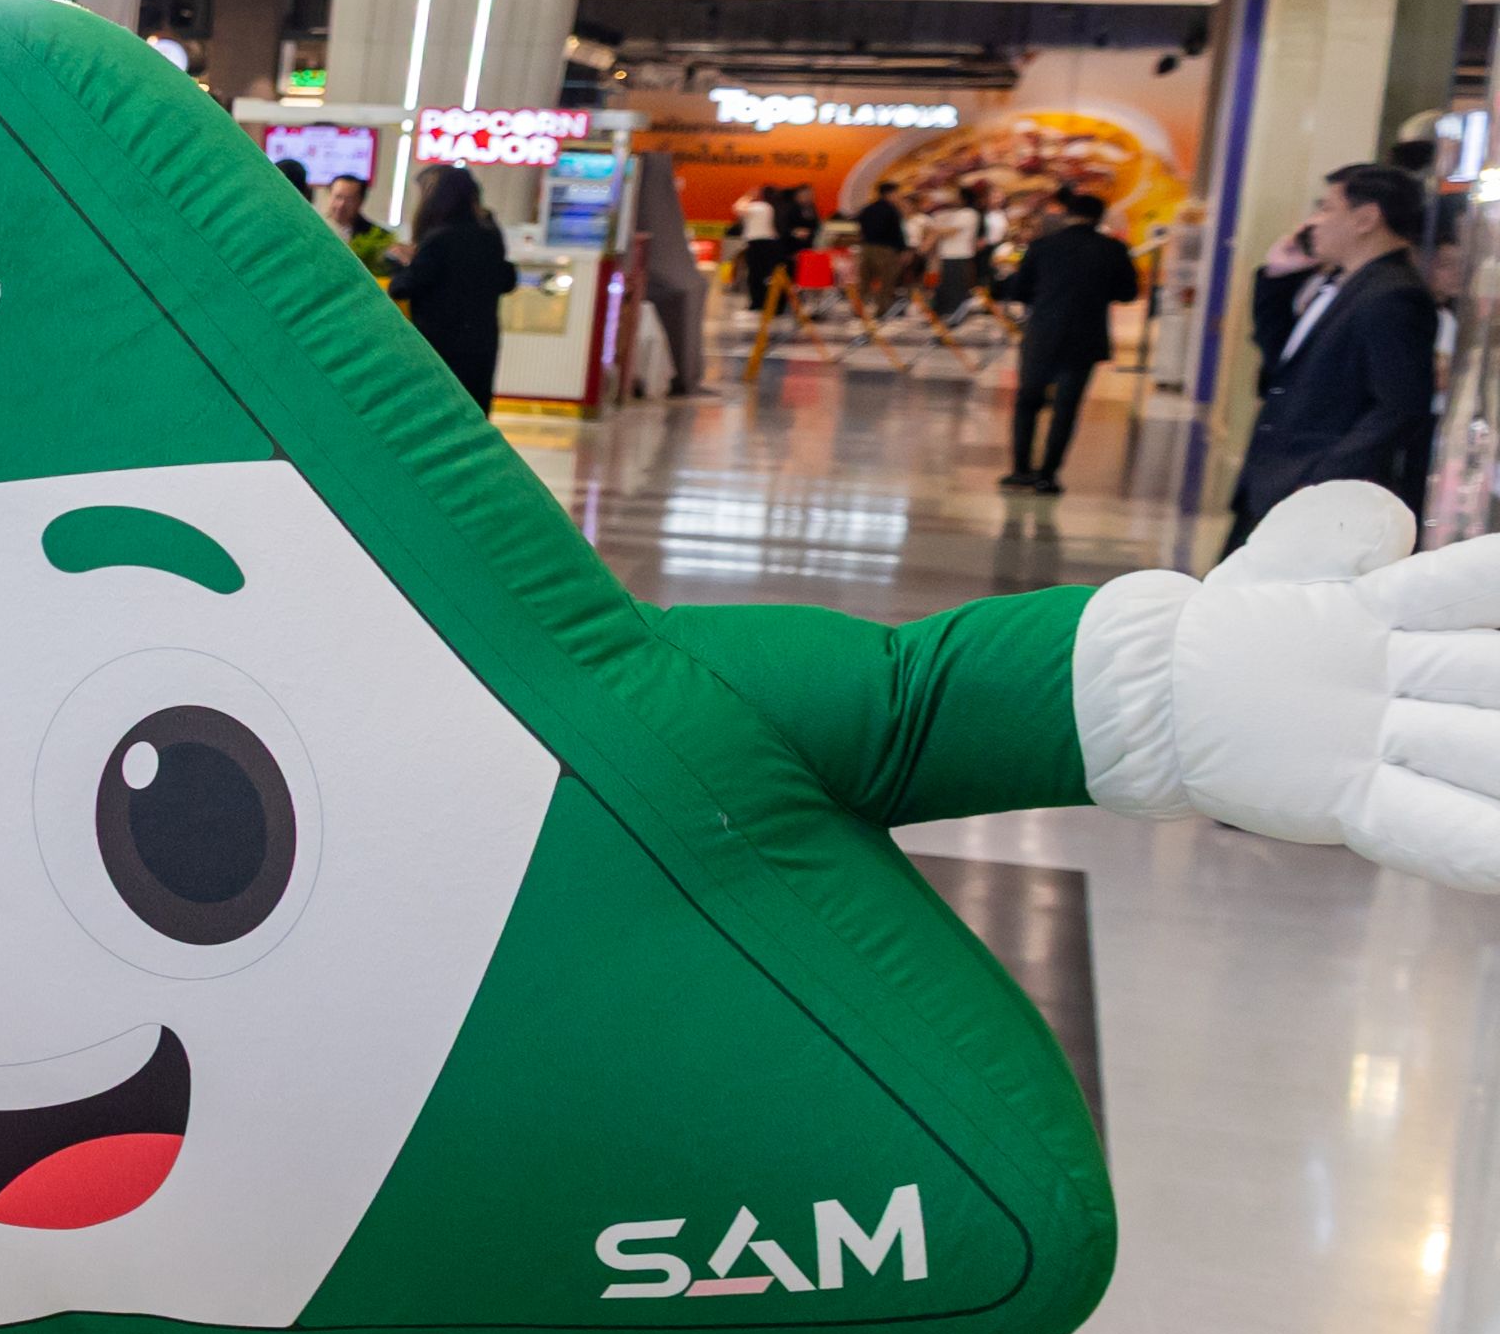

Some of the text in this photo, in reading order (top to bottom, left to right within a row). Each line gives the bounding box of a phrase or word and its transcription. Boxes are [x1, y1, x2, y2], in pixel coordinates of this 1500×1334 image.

[420, 108, 589, 138] POPCORN
[709, 88, 818, 131] Tops
[416, 134, 557, 164] MAJOR
[595, 1183, 929, 1299] SAM
